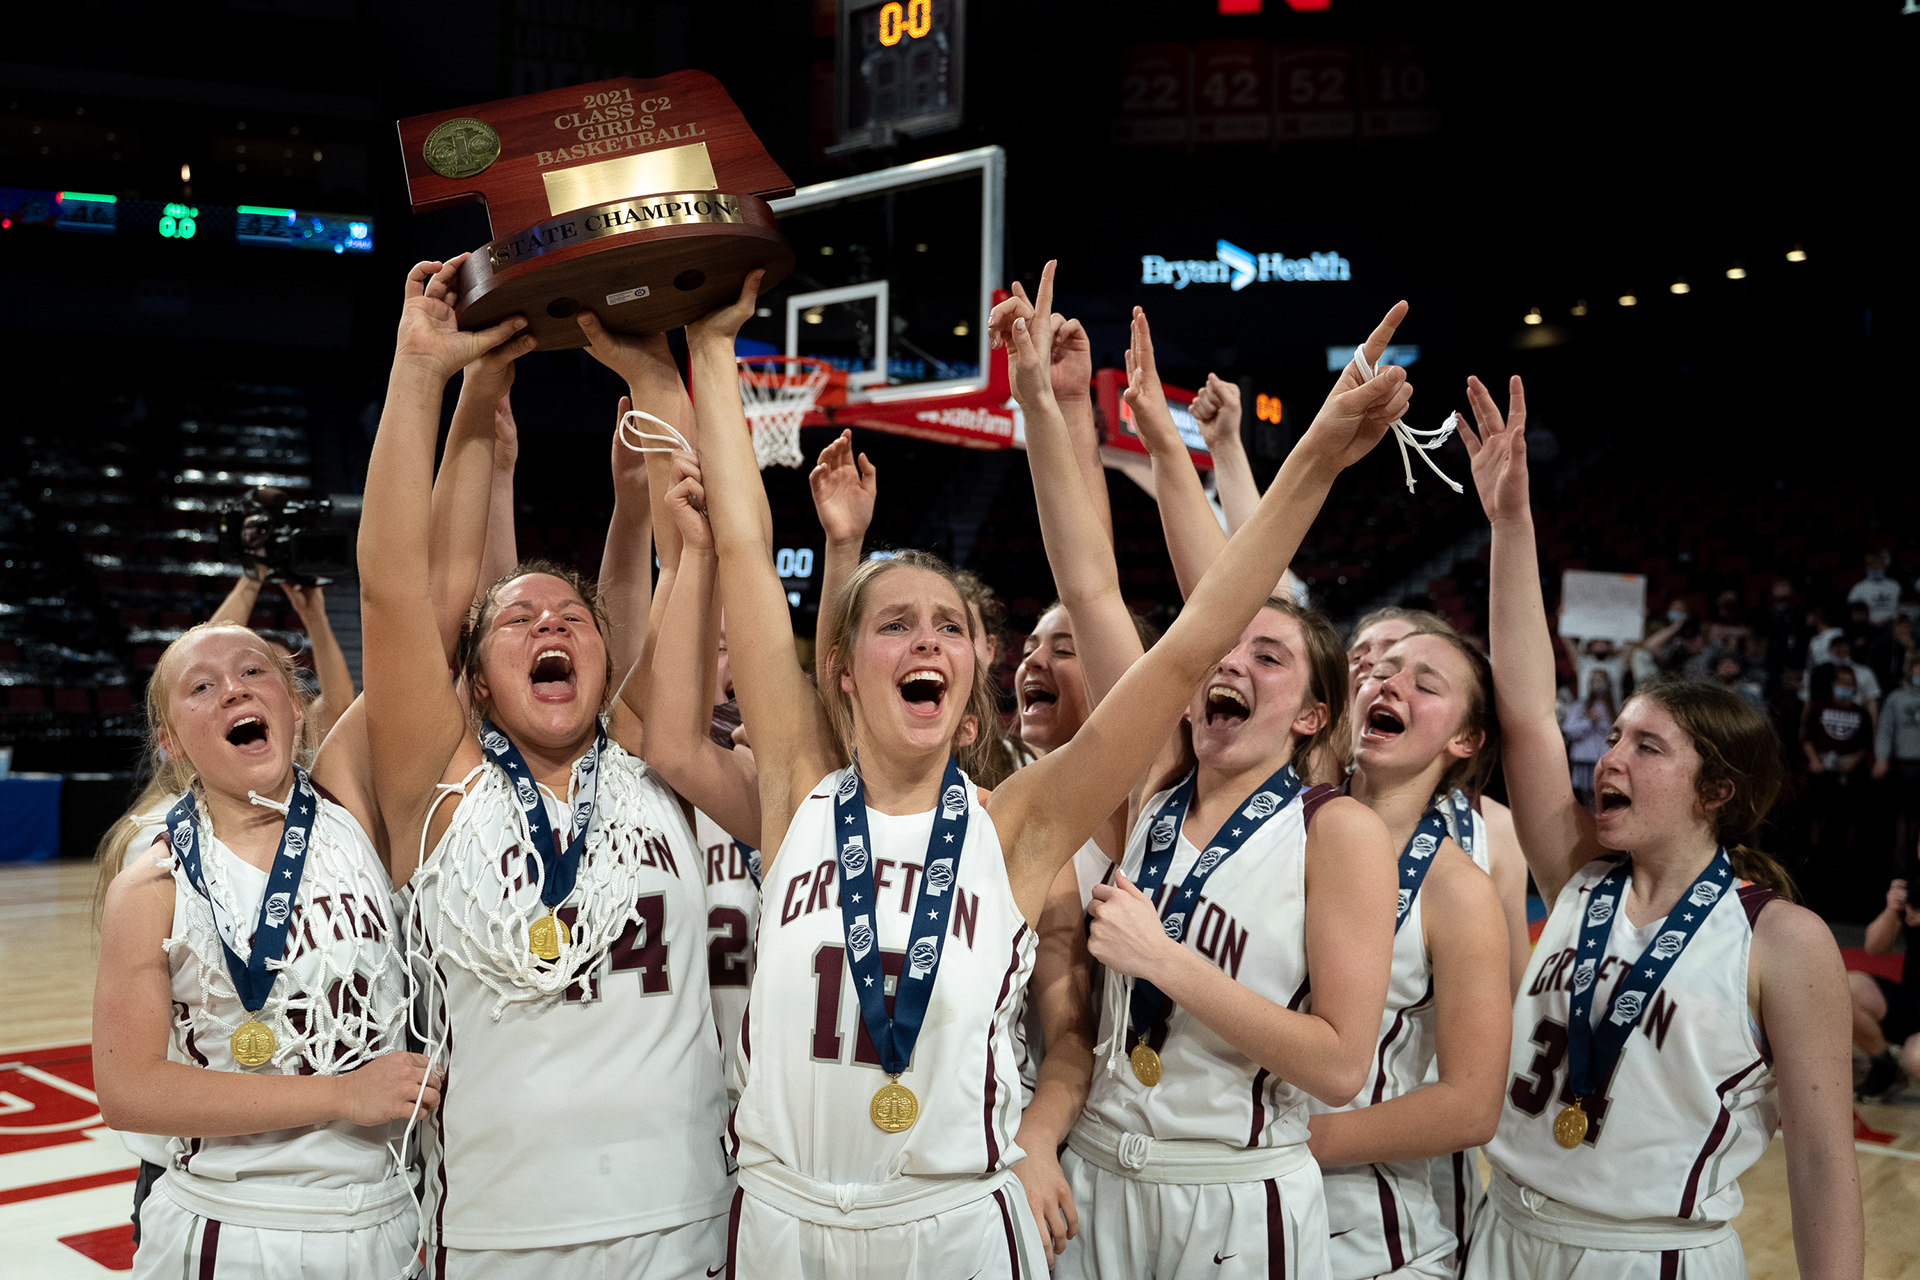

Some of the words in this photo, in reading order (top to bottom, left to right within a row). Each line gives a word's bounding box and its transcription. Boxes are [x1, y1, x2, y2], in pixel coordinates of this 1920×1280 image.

[583, 88, 634, 109] 2021
[1121, 74, 1179, 111] 22
[1201, 69, 1260, 107] 42
[1288, 67, 1347, 104] 52
[1378, 64, 1427, 102] 10
[554, 103, 635, 130] CLASS
[641, 97, 671, 113] C2
[578, 115, 656, 141] GIRLS
[535, 123, 705, 167] BASKETBALL
[495, 221, 578, 264] STATE
[584, 200, 733, 232] CHAMPION
[1141, 254, 1231, 290] Bryan
[1256, 251, 1352, 281] Health
[776, 548, 814, 578] 00
[780, 856, 980, 953] CRFTN
[1528, 947, 1678, 1053] CRFTN
